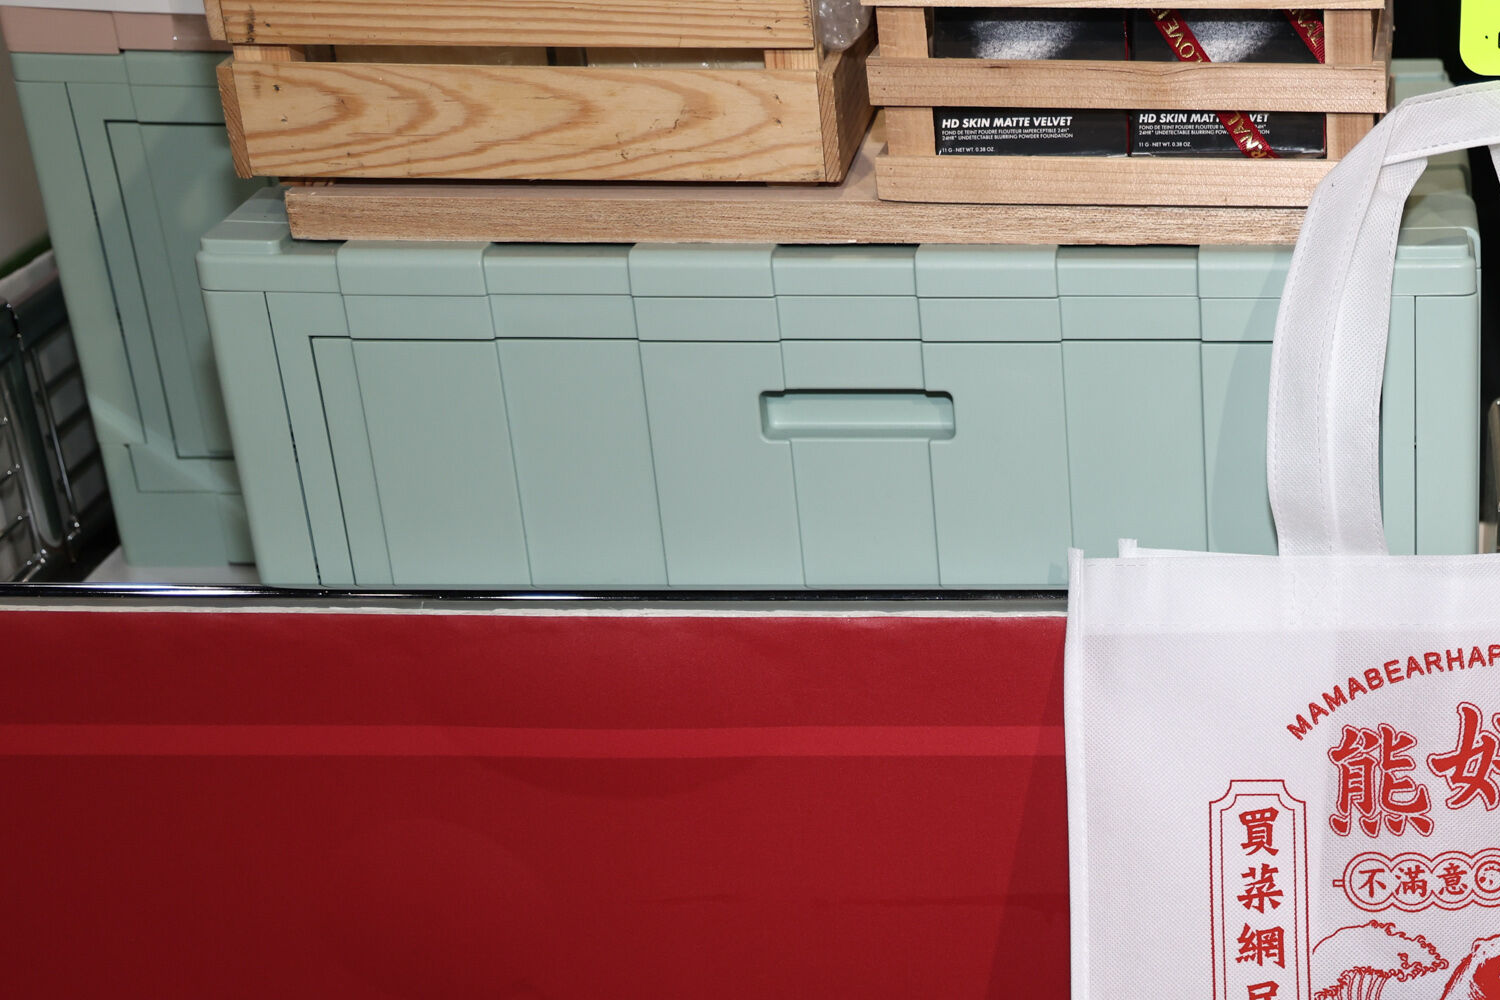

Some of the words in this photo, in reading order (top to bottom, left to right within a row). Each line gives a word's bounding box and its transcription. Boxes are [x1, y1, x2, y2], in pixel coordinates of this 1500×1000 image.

[942, 118, 960, 129] HD
[962, 117, 990, 128] SKIN
[993, 116, 1030, 127] MATTE
[1033, 116, 1073, 127] VELVET
[1139, 113, 1156, 123] HD
[1159, 113, 1187, 123] SKIN
